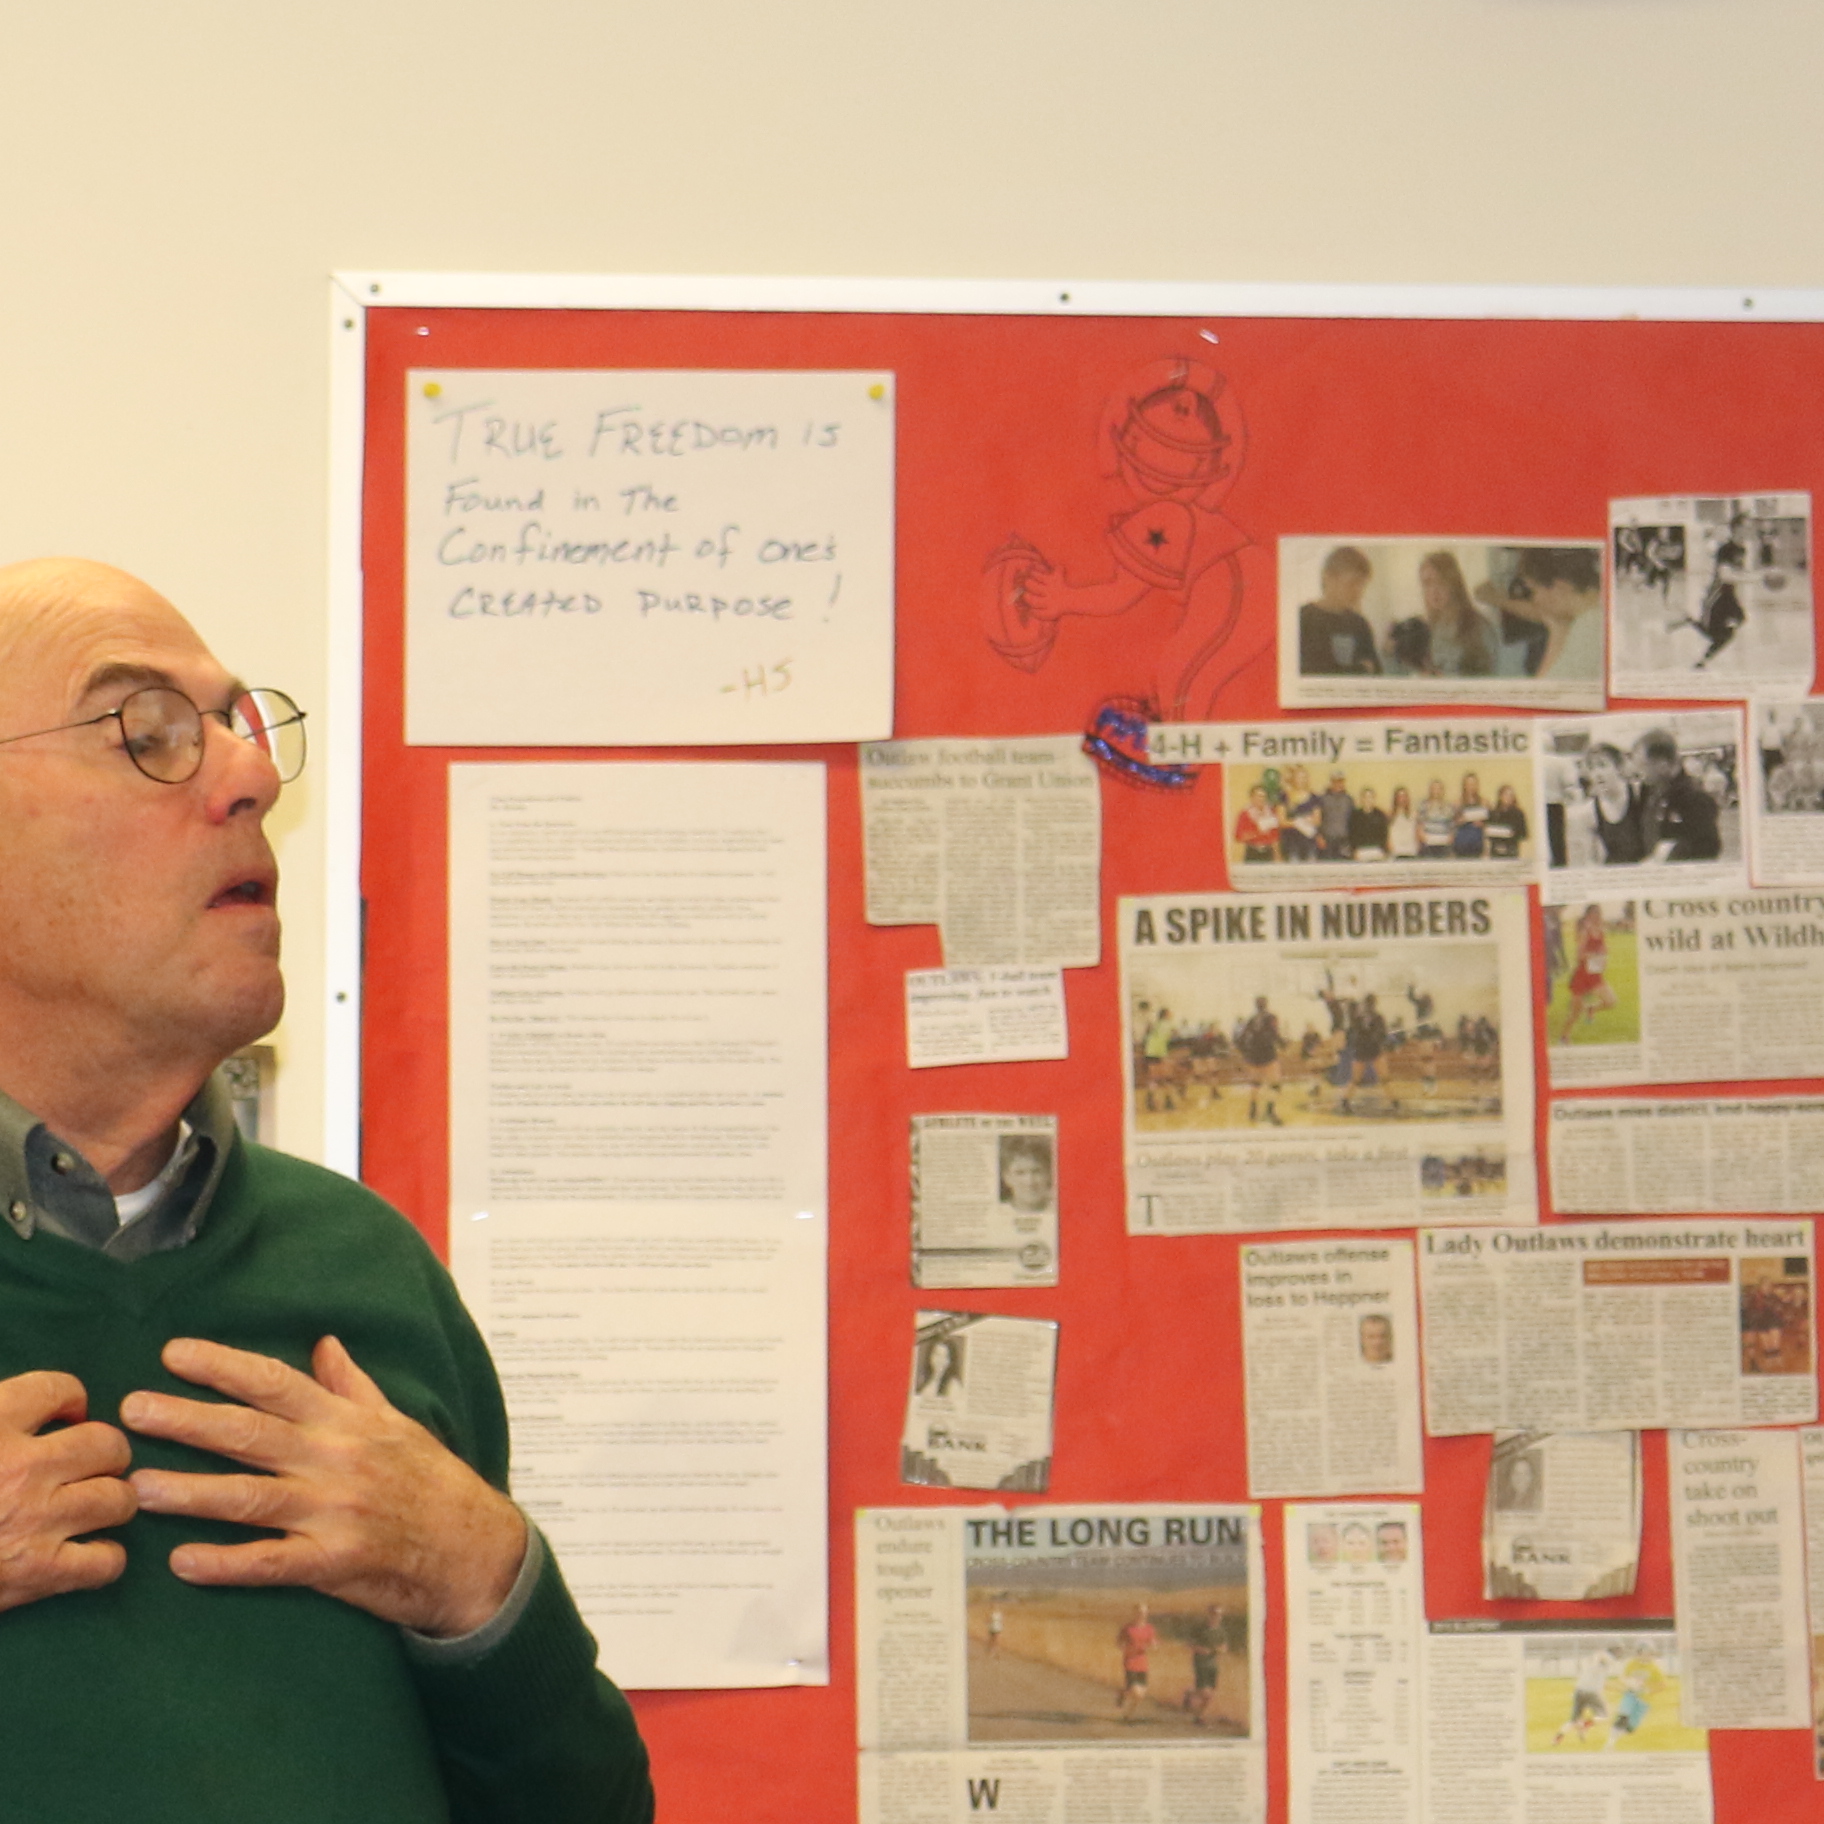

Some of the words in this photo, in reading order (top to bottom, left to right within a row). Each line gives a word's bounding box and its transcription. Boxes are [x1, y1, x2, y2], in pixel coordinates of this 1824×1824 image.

[433, 400, 563, 464] TRUE
[445, 479, 545, 516] Found
[574, 489, 600, 513] in
[438, 520, 680, 567] Confinement
[694, 524, 741, 568] of
[1242, 731, 1345, 763] Family
[1385, 727, 1529, 755] Fantastic
[937, 748, 1005, 766] football
[1011, 751, 1055, 765] team
[1644, 897, 1720, 918] Cross
[1135, 909, 1157, 945] A
[1166, 905, 1266, 945] SPIKE
[1277, 904, 1310, 940] IN
[1321, 899, 1491, 940] NUMBERS
[1645, 929, 1701, 951] wild
[1711, 931, 1734, 950] at
[1137, 1195, 1161, 1226] T
[1426, 1234, 1482, 1258] Lady
[1492, 1232, 1588, 1253] Outlaws
[1595, 1229, 1737, 1251] demonstrate
[1744, 1228, 1805, 1248] heart
[1247, 1251, 1319, 1265] Outlaws
[1323, 1248, 1389, 1262] offense
[1247, 1272, 1328, 1287] improves
[1335, 1270, 1352, 1282] in
[1247, 1294, 1285, 1307] loss
[1290, 1292, 1308, 1305] to
[1313, 1290, 1389, 1308] Heppner
[1681, 1431, 1746, 1449] Cross-
[1682, 1457, 1759, 1477] country
[1684, 1484, 1726, 1500] take
[1732, 1485, 1757, 1498] on
[876, 1516, 946, 1532] Outlaws
[1686, 1509, 1740, 1526] shoot
[1746, 1508, 1778, 1524] out
[967, 1519, 1037, 1547] THE
[1049, 1517, 1150, 1547] LONG
[1164, 1516, 1242, 1546] RUN
[877, 1538, 933, 1555] endure
[877, 1560, 925, 1579] tough
[877, 1585, 933, 1603] opener
[967, 1778, 1001, 1811] W
